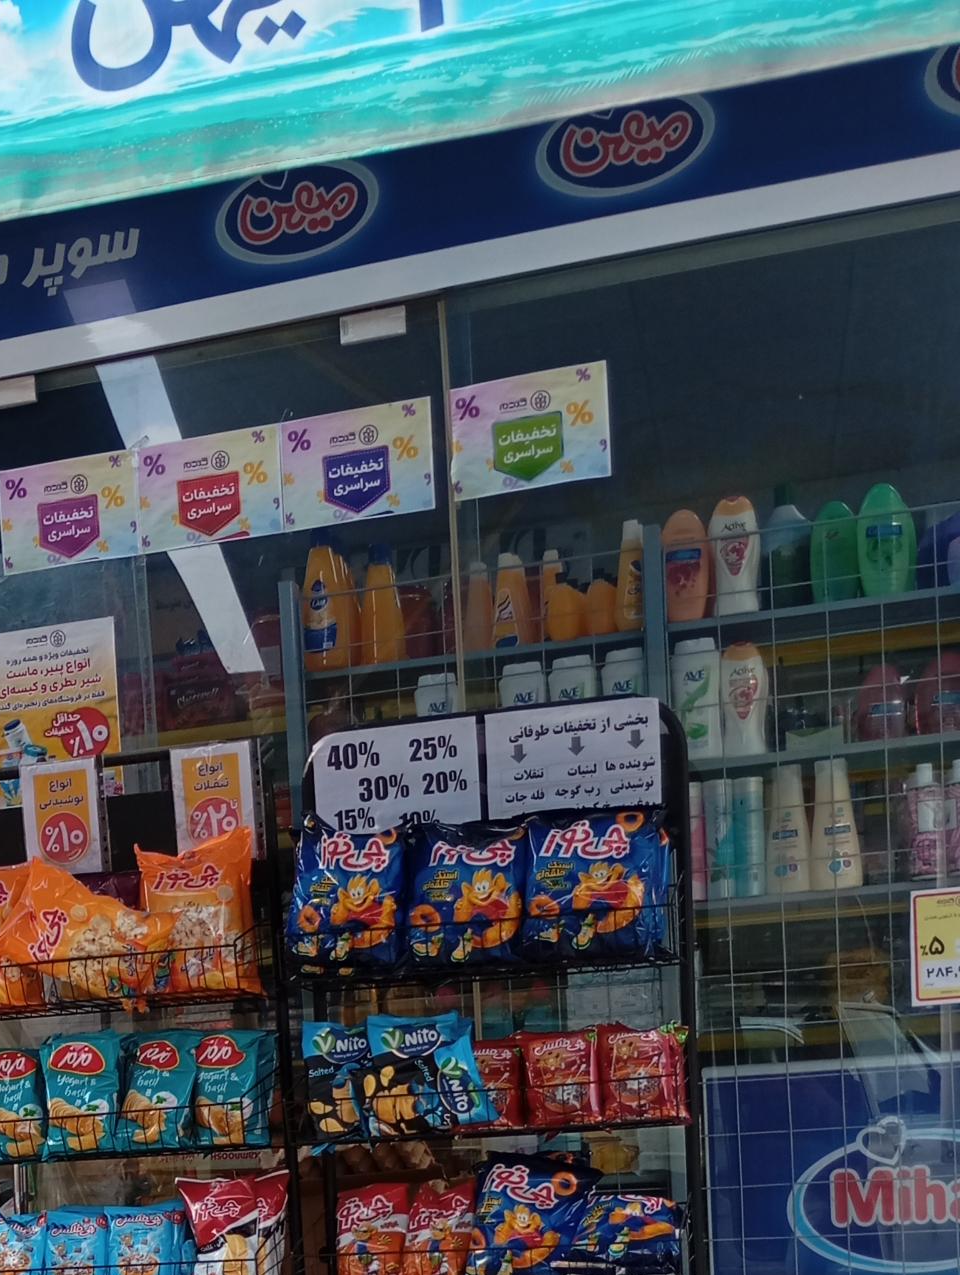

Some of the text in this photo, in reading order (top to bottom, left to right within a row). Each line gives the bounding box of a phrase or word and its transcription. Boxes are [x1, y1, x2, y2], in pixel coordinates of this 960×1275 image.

[560, 110, 693, 177] میهن
[239, 180, 358, 244] میهن
[22, 227, 140, 296] سوپر
[498, 424, 557, 446] تخفیفات
[503, 444, 553, 464] سراسری
[328, 459, 384, 478] تخفیفات
[182, 484, 235, 502] تخفیفات
[333, 476, 381, 496] سراسری
[42, 506, 94, 526] تخفیفات
[187, 502, 231, 520] سراسری
[47, 525, 91, 543] سراسری
[6, 667, 38, 680] ماست
[66, 658, 91, 671] انواع
[80, 673, 102, 688] شیر
[683, 667, 705, 681] AVE
[49, 678, 77, 692] بطری
[53, 711, 81, 726] حداقل
[509, 713, 648, 744] بخشی از تخفیفات طوفانی
[327, 734, 457, 770] 40% 25%
[197, 762, 223, 776] انواع
[514, 756, 655, 781] شوینده ها لبنیات تنقلات
[49, 777, 72, 793] انواع
[194, 777, 228, 792] تنقلات
[358, 769, 467, 802] 30% 20%
[611, 777, 654, 794] نوشیدنی
[40, 794, 84, 810] نوشیدنی
[334, 807, 375, 831] 15%
[312, 1028, 367, 1054] V.Nito
[381, 1028, 438, 1049] V.Nito
[309, 1067, 335, 1078] Salted
